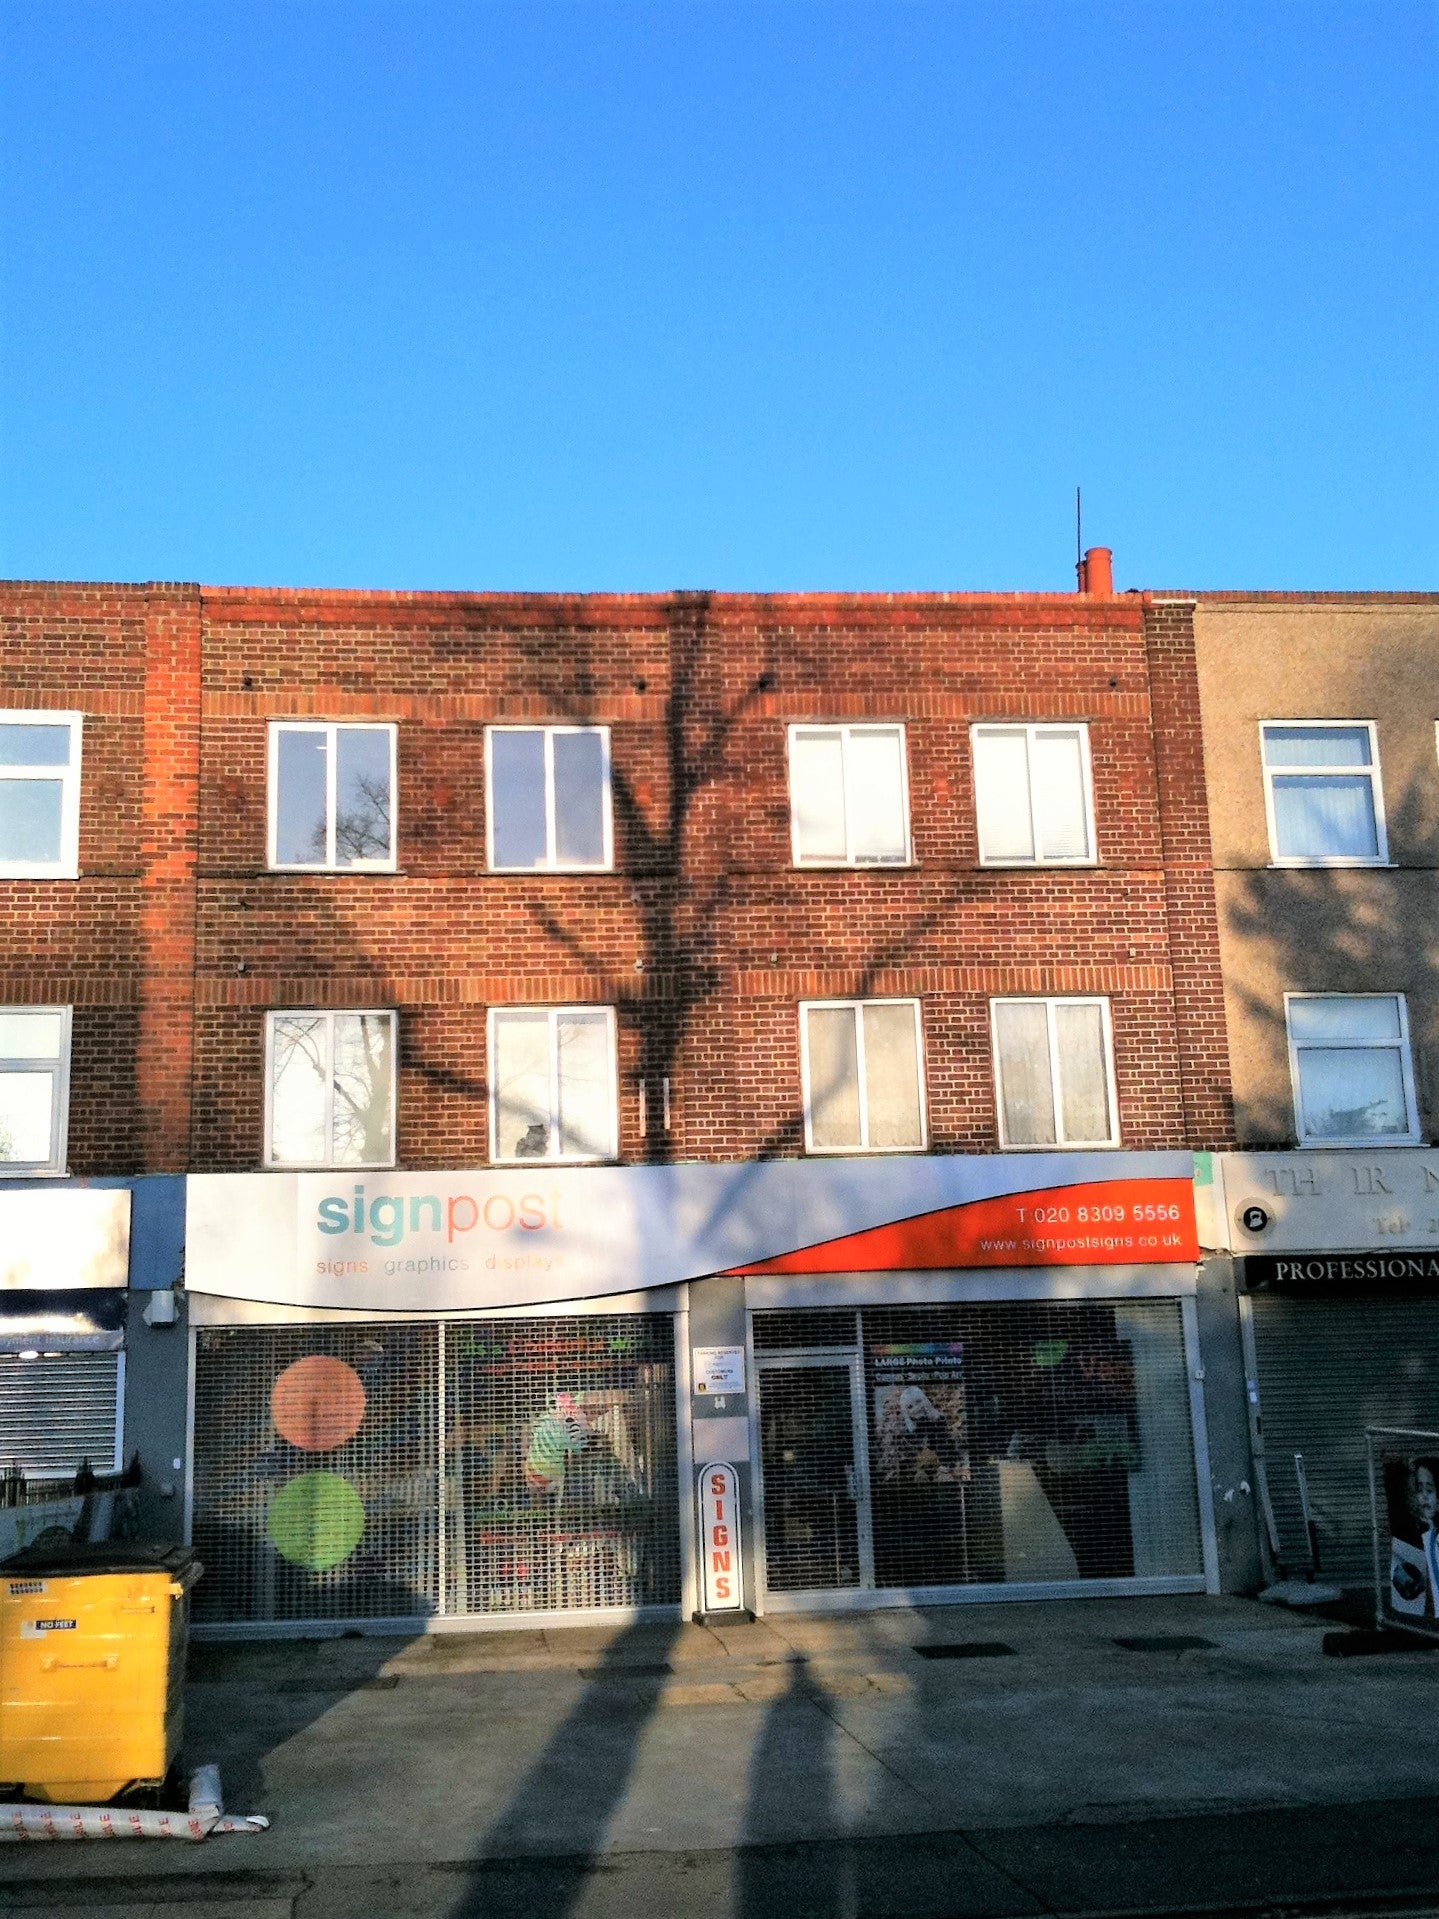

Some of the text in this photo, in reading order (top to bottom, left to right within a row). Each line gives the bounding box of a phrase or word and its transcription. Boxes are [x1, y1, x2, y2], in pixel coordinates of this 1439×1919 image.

[317, 1185, 564, 1247] signpost
[1016, 1204, 1181, 1223] T 020 8309 5556
[316, 1258, 369, 1277] signs
[384, 1256, 470, 1275] graphics
[710, 1473, 731, 1599] SIGNS
